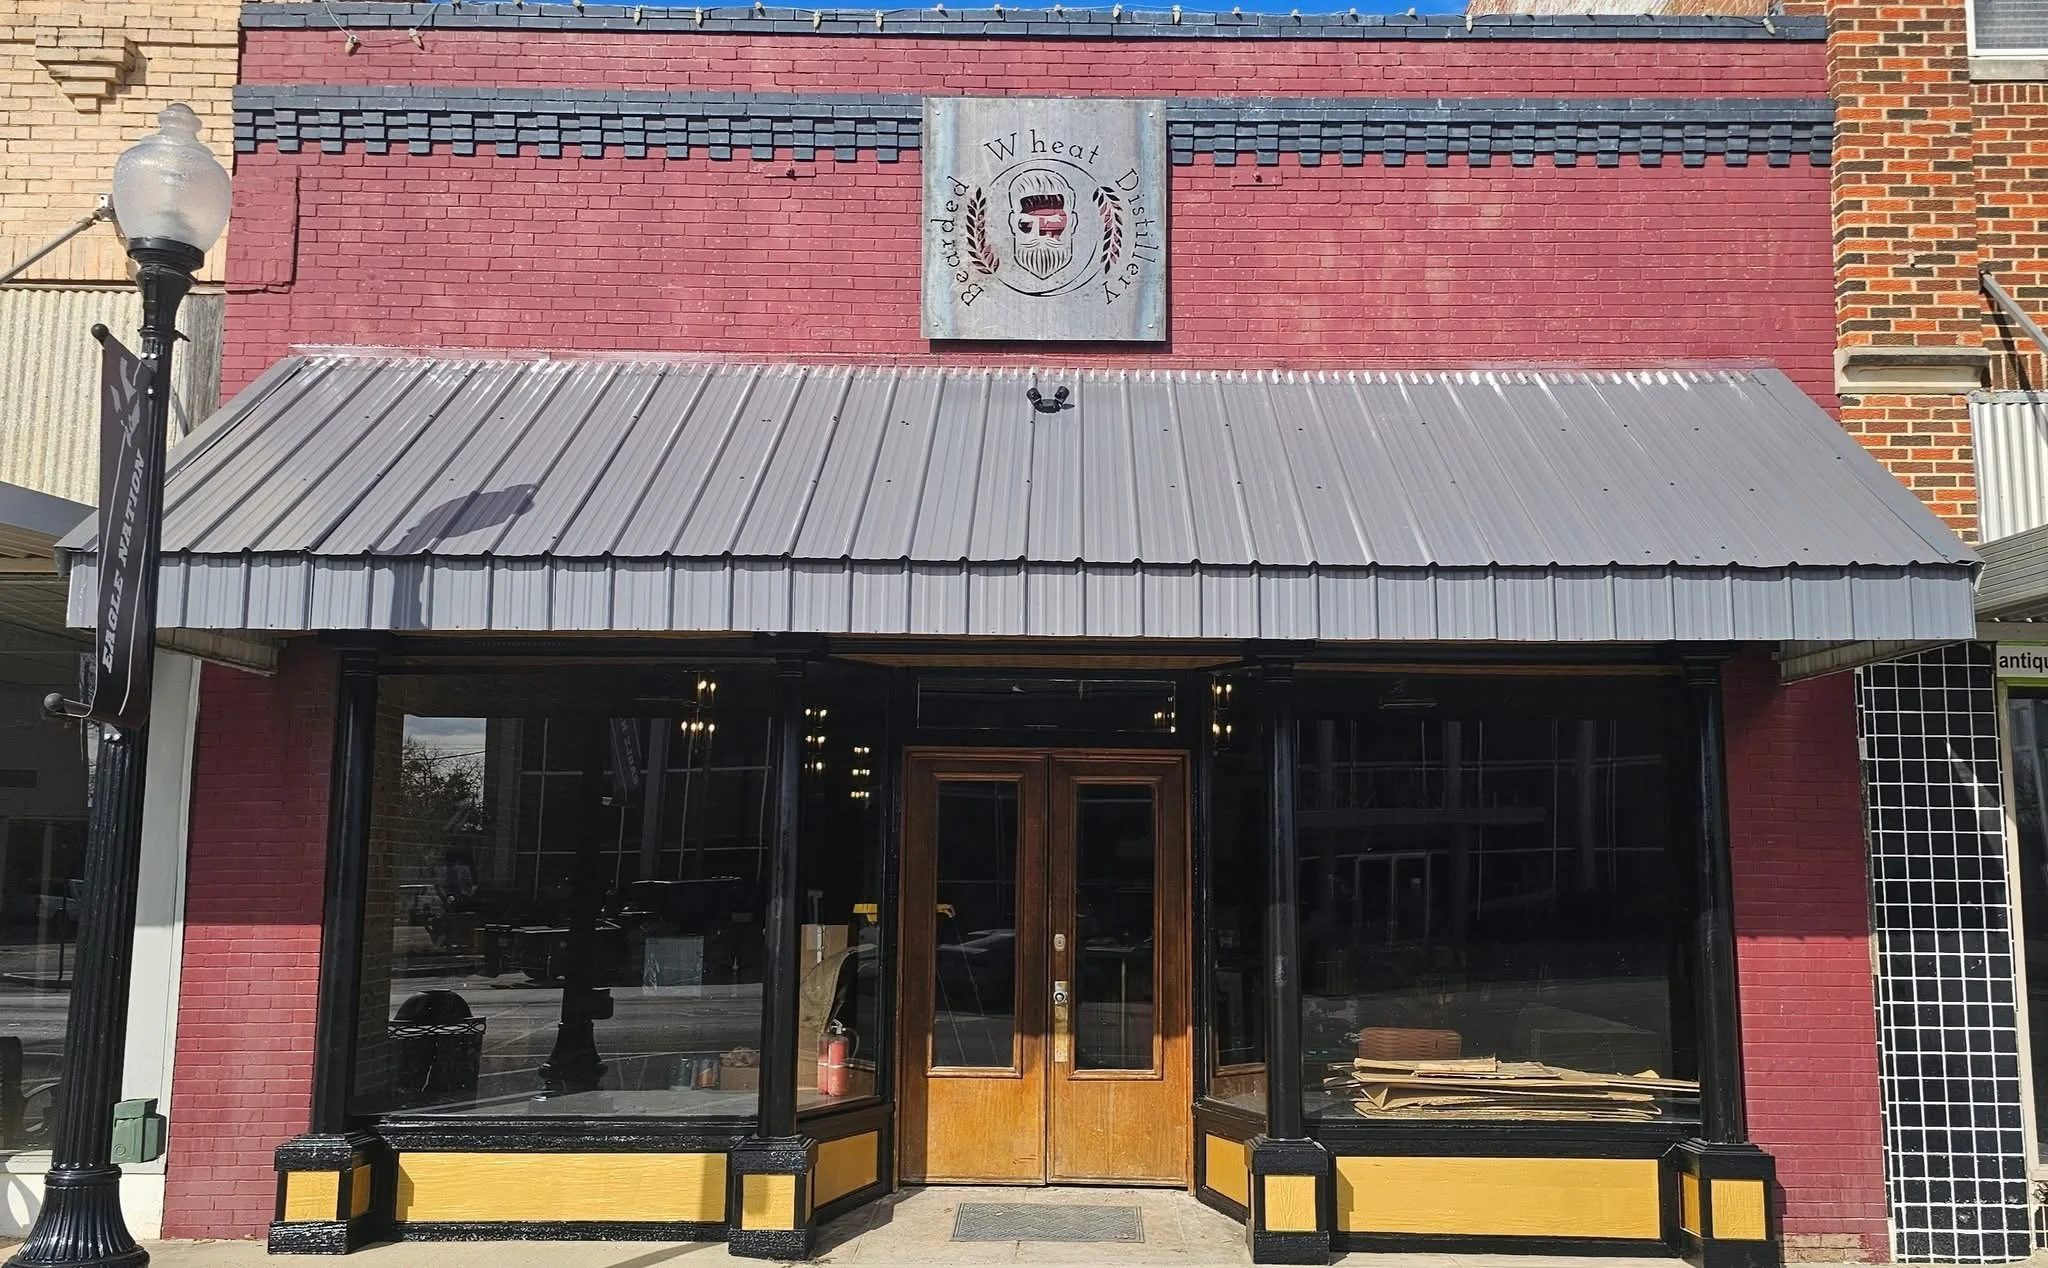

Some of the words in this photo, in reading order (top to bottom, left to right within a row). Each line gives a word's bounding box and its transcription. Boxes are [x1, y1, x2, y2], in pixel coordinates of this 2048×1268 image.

[931, 176, 984, 306] Bearded
[984, 130, 1100, 165] Wheat
[1102, 168, 1159, 304] Distillery
[102, 569, 124, 673] EAGLE
[118, 448, 145, 567] NATION
